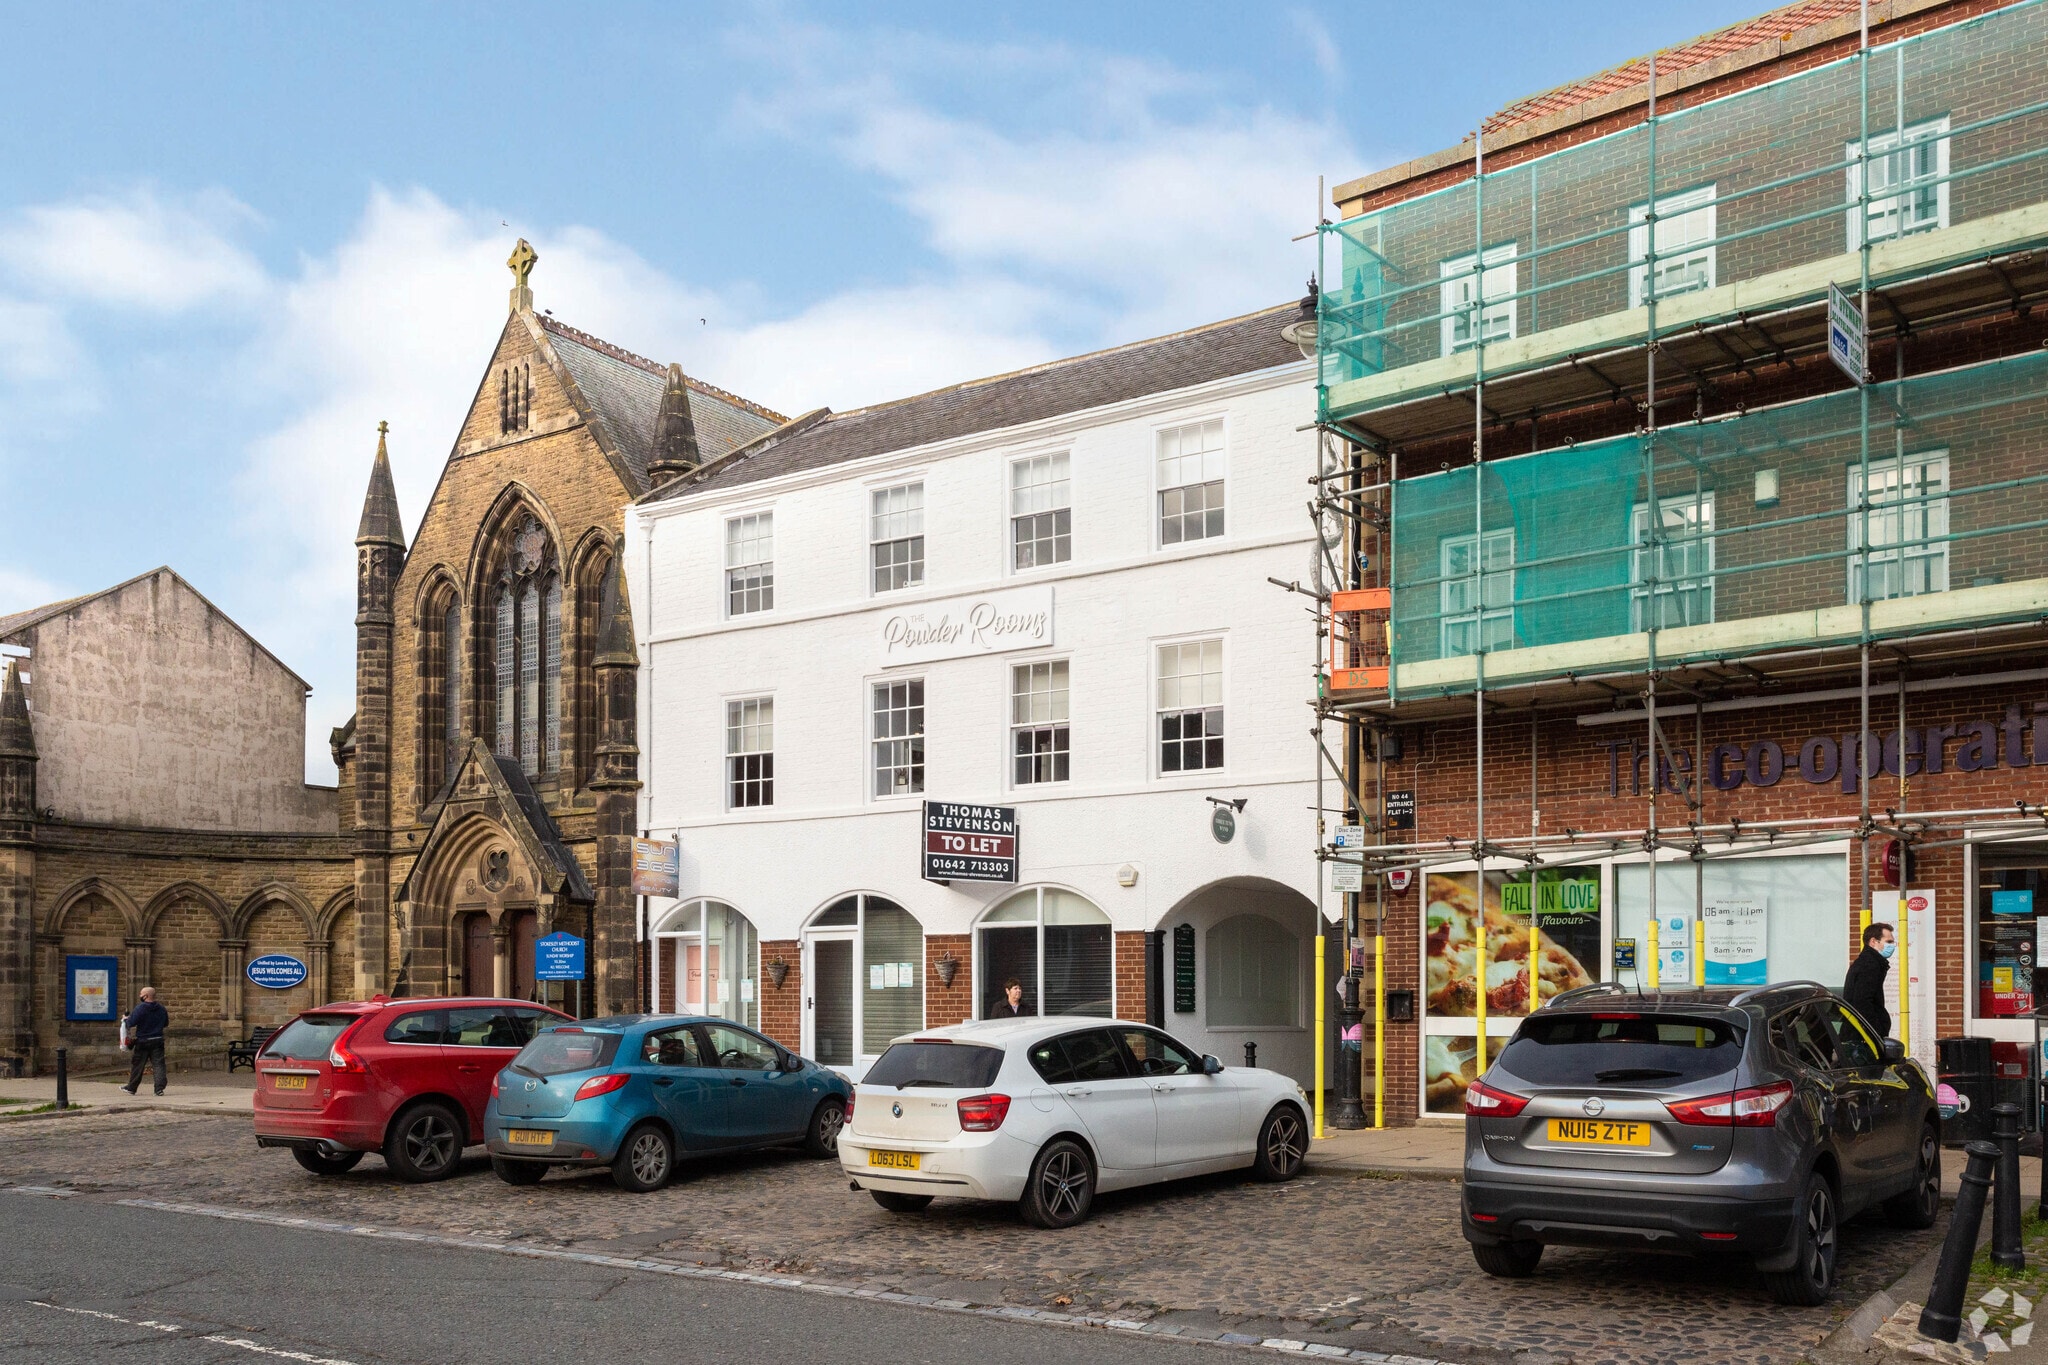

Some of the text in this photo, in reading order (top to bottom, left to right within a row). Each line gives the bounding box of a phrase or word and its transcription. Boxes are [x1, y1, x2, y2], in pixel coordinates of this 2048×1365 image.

[910, 614, 925, 623] THE
[885, 602, 1047, 653] Powder Rooms
[1348, 671, 1369, 687] DS
[1599, 738, 1692, 799] The
[1387, 800, 1414, 808] ENTRANCE
[941, 804, 1002, 820] THOMAS
[929, 815, 1013, 833] STEVENSON
[941, 835, 1002, 853] TO LET
[636, 859, 676, 874] 365
[932, 858, 1010, 873] 01642 713303
[938, 870, 1004, 879] www.thomas-stevenson.co.uk
[640, 885, 672, 894] BEAUTY
[1504, 883, 1595, 911] FALL IN LOVE
[1750, 908, 1764, 916] pm
[1713, 946, 1731, 954] 8am
[1736, 946, 1754, 954] 9am
[251, 967, 303, 976] JESUS WELCOMES ALL
[292, 1077, 305, 1088] CXR
[530, 1131, 547, 1143] HTF
[1558, 1121, 1638, 1141] NU15 ZTF
[896, 1154, 915, 1168] LSL
